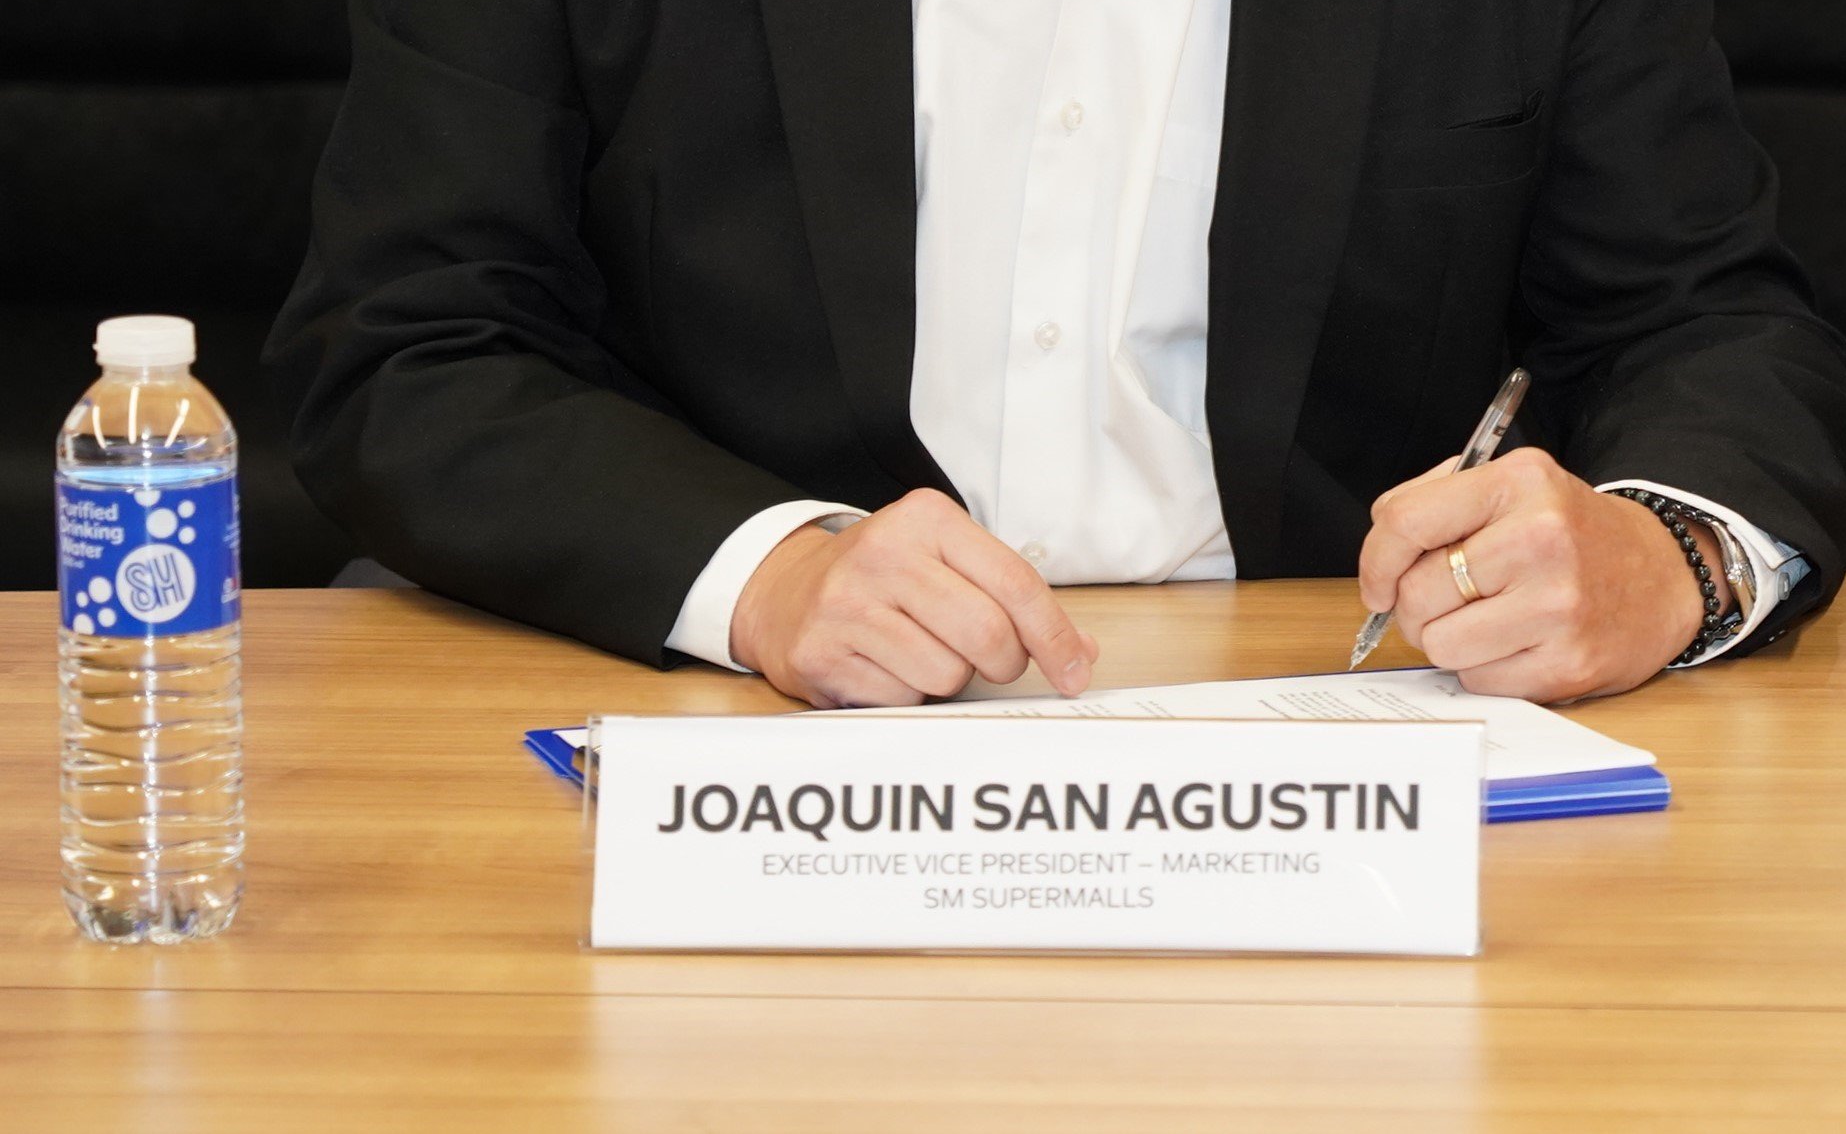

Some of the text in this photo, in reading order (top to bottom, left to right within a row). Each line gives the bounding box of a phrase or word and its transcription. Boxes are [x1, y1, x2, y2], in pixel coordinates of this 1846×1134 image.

[657, 782, 1420, 842] JOAQUIN SAN AGUSTIN
[762, 853, 908, 876] EXECUTIVE
[915, 853, 972, 875] VICE
[981, 852, 1131, 875] PRESIDENT
[1162, 852, 1320, 874] MARKETING
[924, 886, 1154, 909] SM SUPERMALLS
